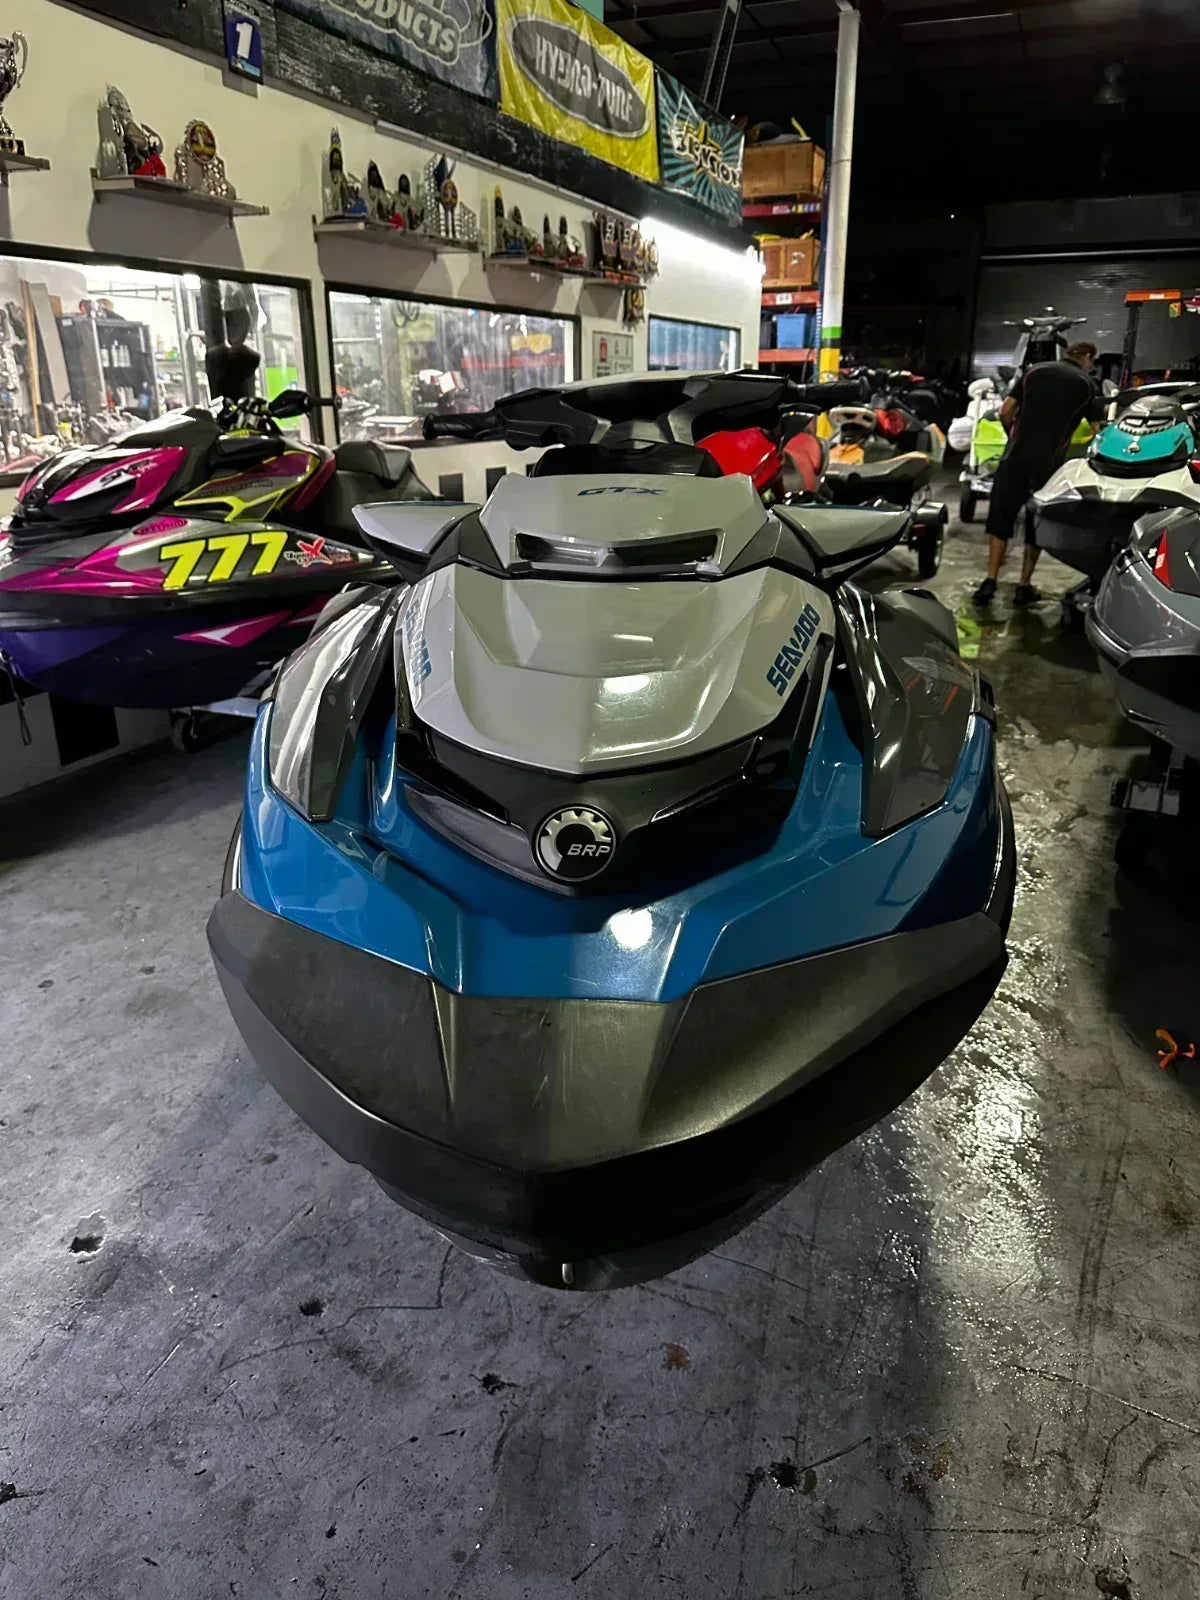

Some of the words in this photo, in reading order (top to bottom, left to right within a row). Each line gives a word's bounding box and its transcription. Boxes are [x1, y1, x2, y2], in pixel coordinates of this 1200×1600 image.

[236, 22, 253, 59] 1
[577, 486, 665, 496] GTX
[160, 531, 289, 591] 777
[567, 843, 611, 857] BRP
